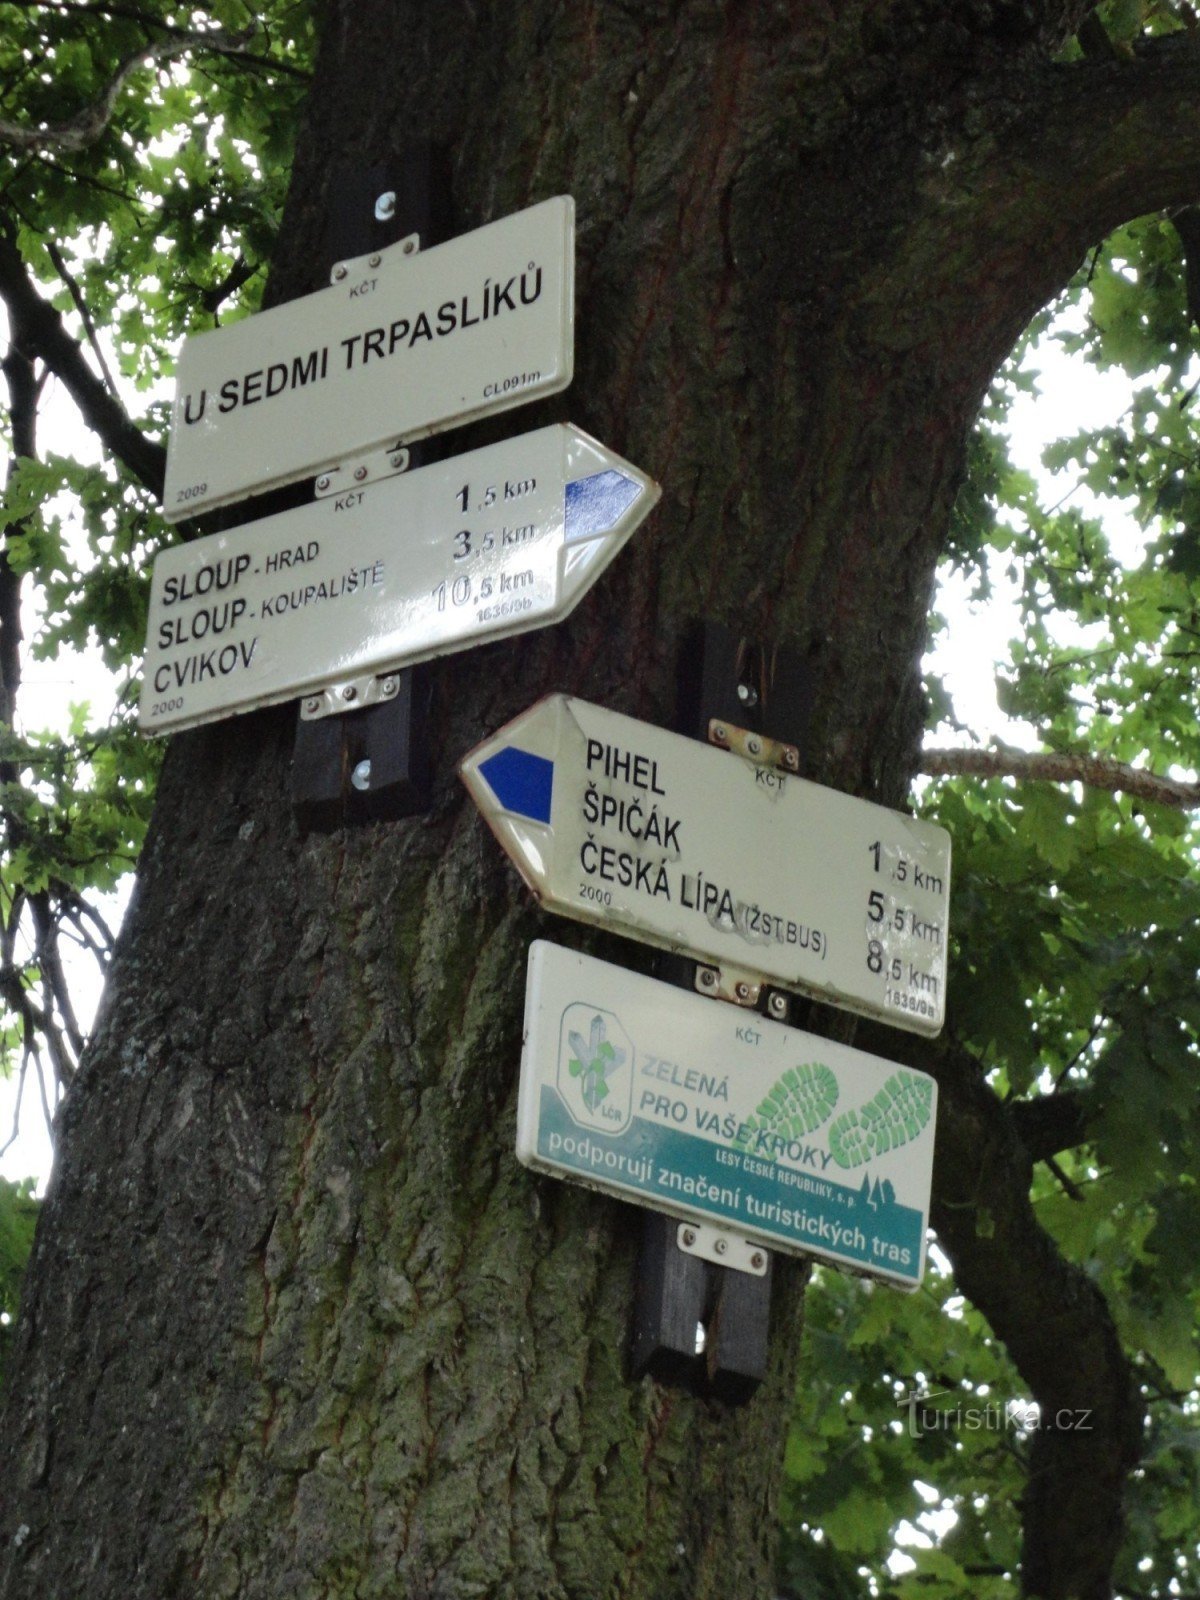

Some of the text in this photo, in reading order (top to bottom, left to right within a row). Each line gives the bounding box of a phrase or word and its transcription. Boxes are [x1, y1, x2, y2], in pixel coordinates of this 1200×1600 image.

[349, 279, 379, 299] KČT
[184, 261, 543, 425] U SEDMI TRPASLÍKŮ
[483, 371, 541, 398] CL091m
[176, 483, 208, 503] 2009
[334, 492, 365, 512] KČT
[504, 478, 537, 499] km
[453, 524, 536, 561] 3,5 km
[162, 554, 251, 607] SLOUP
[265, 541, 320, 575] HRAD
[432, 569, 534, 612] 10,5 km
[157, 598, 247, 650] SLOUP
[260, 560, 386, 620] KOUPALIŠTĚ
[154, 638, 258, 693] CVIKOV
[152, 697, 185, 717] 2000
[586, 737, 666, 796] PIHEL
[755, 768, 785, 791] KČT
[582, 781, 682, 853] ŠPIČÁK
[578, 882, 613, 906] 2000
[580, 831, 672, 902] ČESKÁ
[679, 871, 736, 924] LÍPA
[914, 865, 943, 895] km
[867, 890, 941, 946] 5,5 km
[866, 939, 938, 994] 8,5 km
[735, 1026, 762, 1046] KČT
[640, 1055, 730, 1102] ZELENÁ
[640, 1090, 834, 1172] PRO VAŠE KROKY
[715, 1149, 741, 1168] LESY
[743, 1157, 776, 1181] ČESKÉ
[549, 1132, 913, 1266] podporují značení turistických tras
